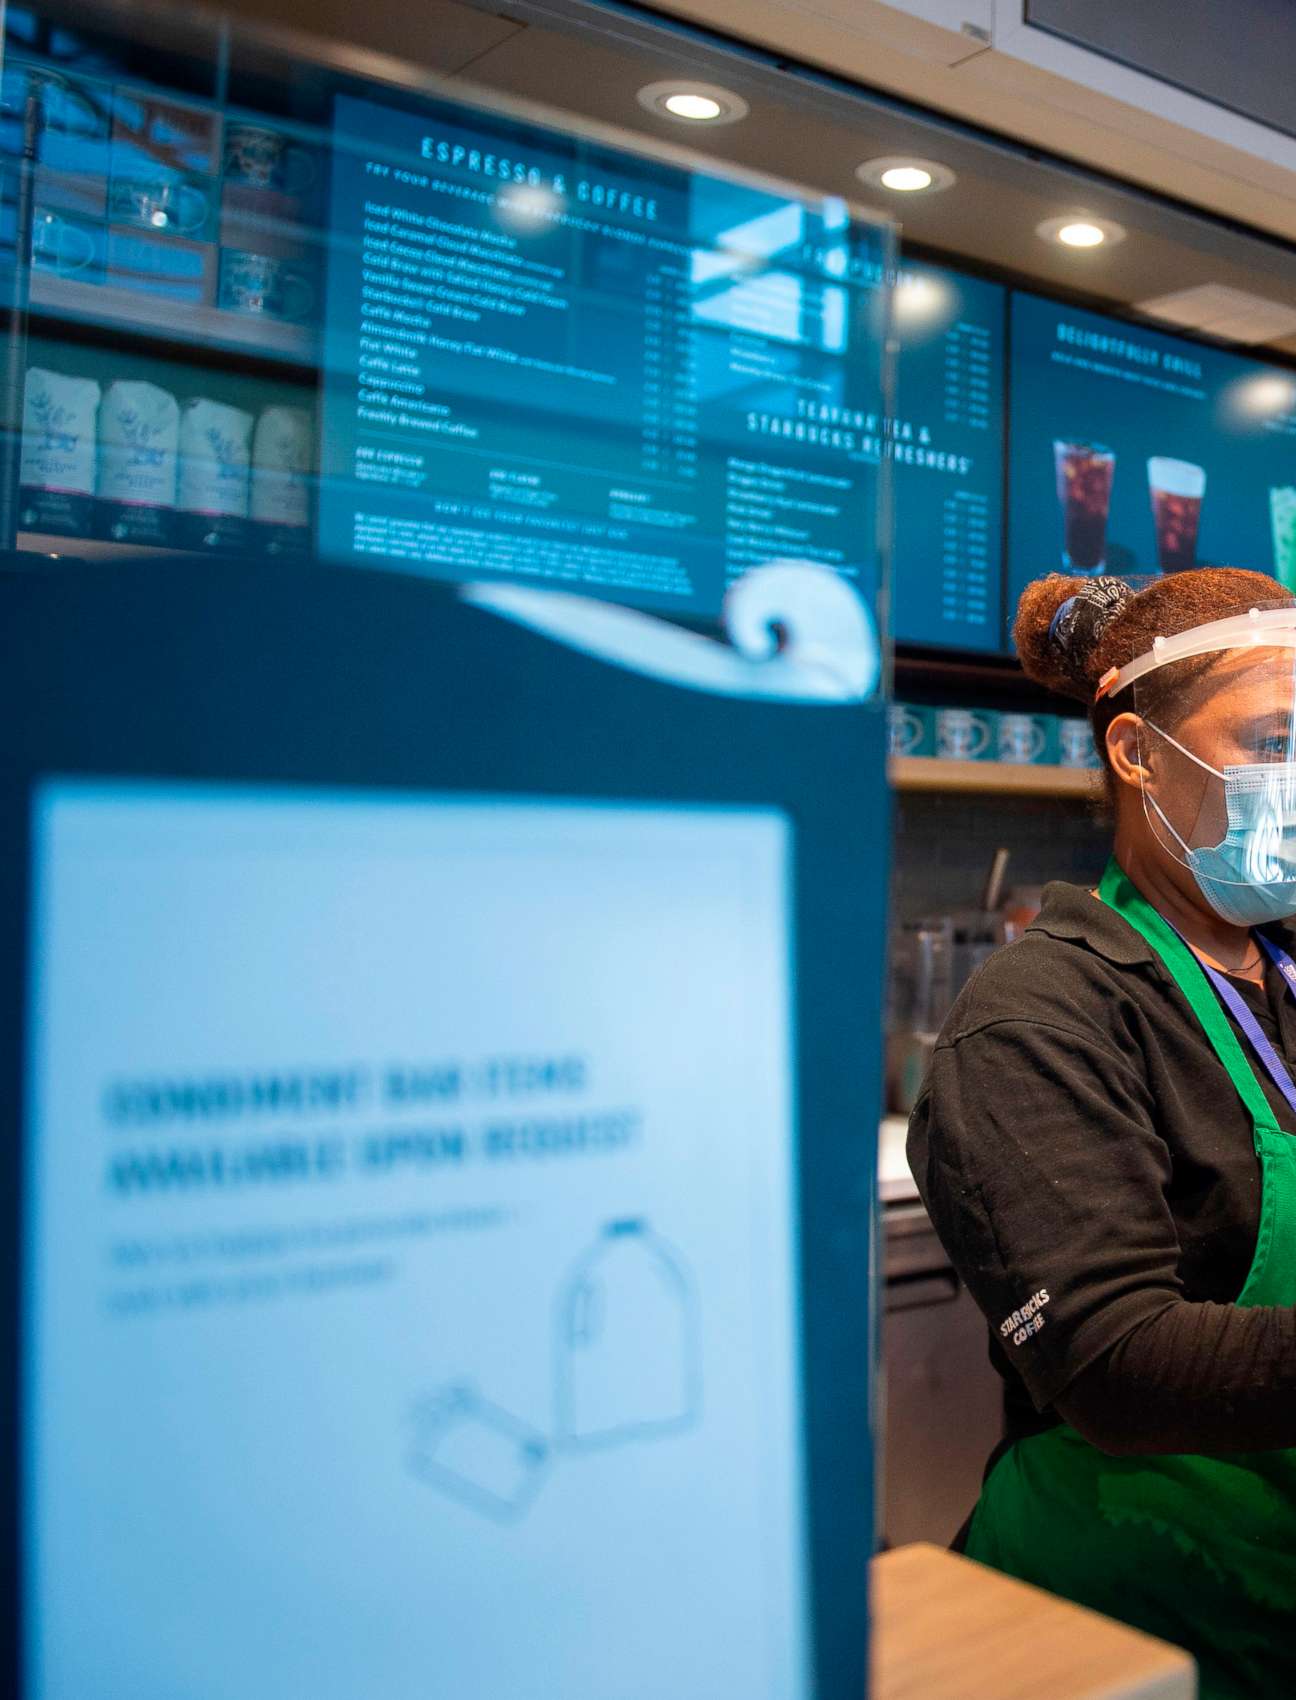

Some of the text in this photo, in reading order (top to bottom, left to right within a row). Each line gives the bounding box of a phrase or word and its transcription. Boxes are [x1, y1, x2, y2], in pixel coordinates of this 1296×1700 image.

[421, 136, 541, 187] ESPRESSO
[553, 174, 566, 195] &
[577, 180, 657, 221] COFFEE
[747, 412, 855, 449] STARBUCKS
